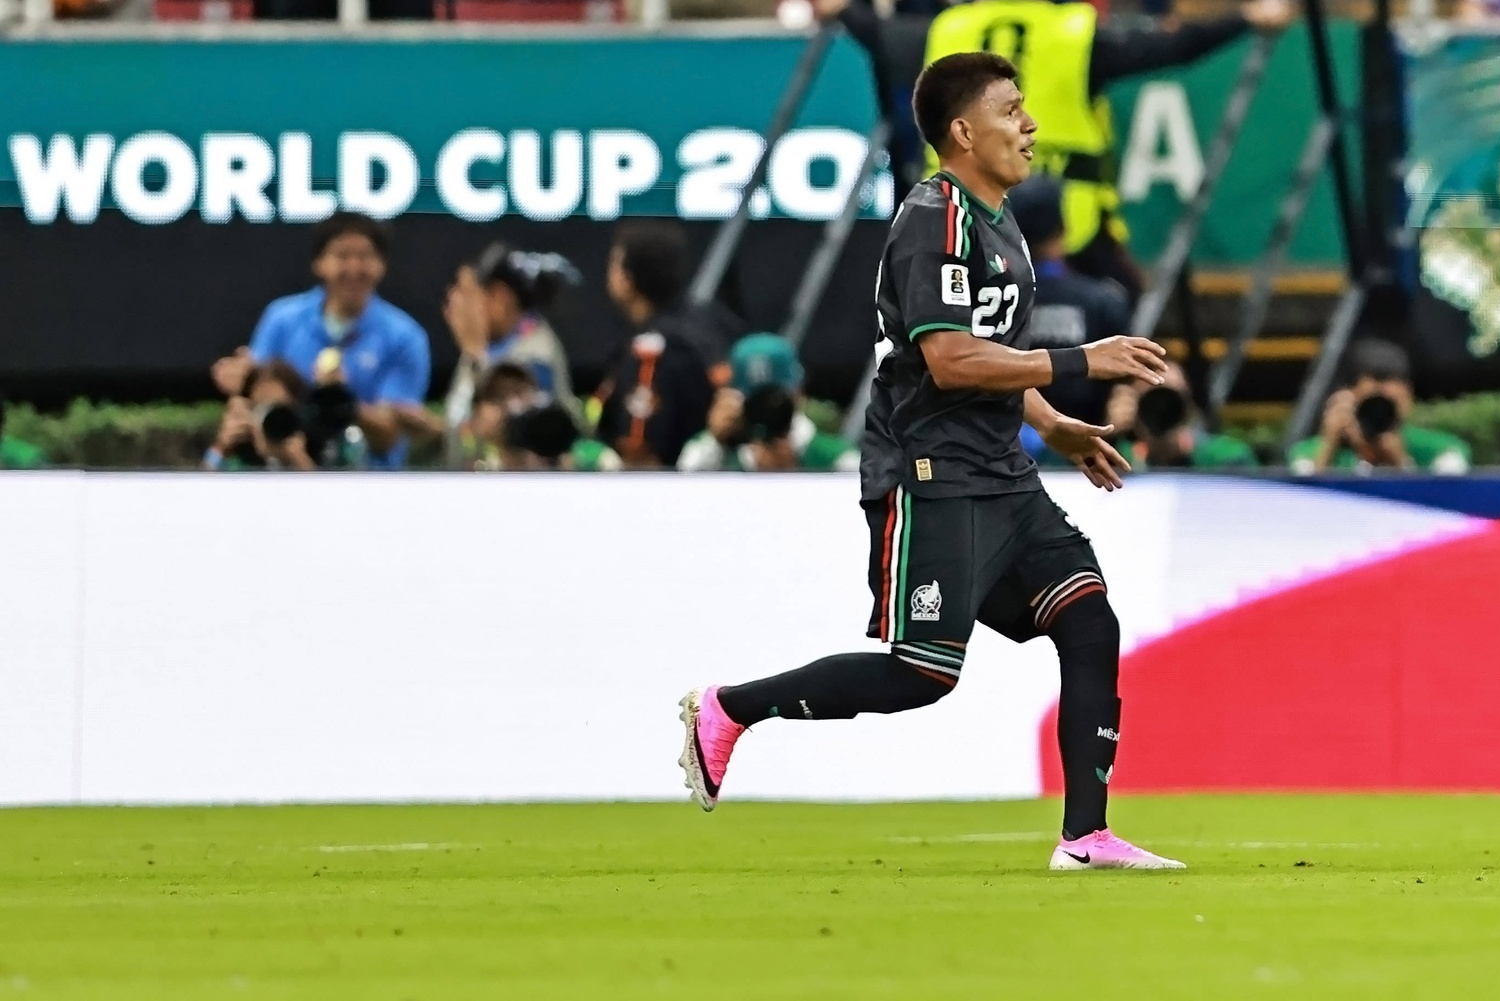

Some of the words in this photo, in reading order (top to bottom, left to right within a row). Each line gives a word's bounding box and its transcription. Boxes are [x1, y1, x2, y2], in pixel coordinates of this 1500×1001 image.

[8, 129, 420, 225] WORLD
[434, 126, 662, 222] CUP
[971, 283, 1019, 337] 23
